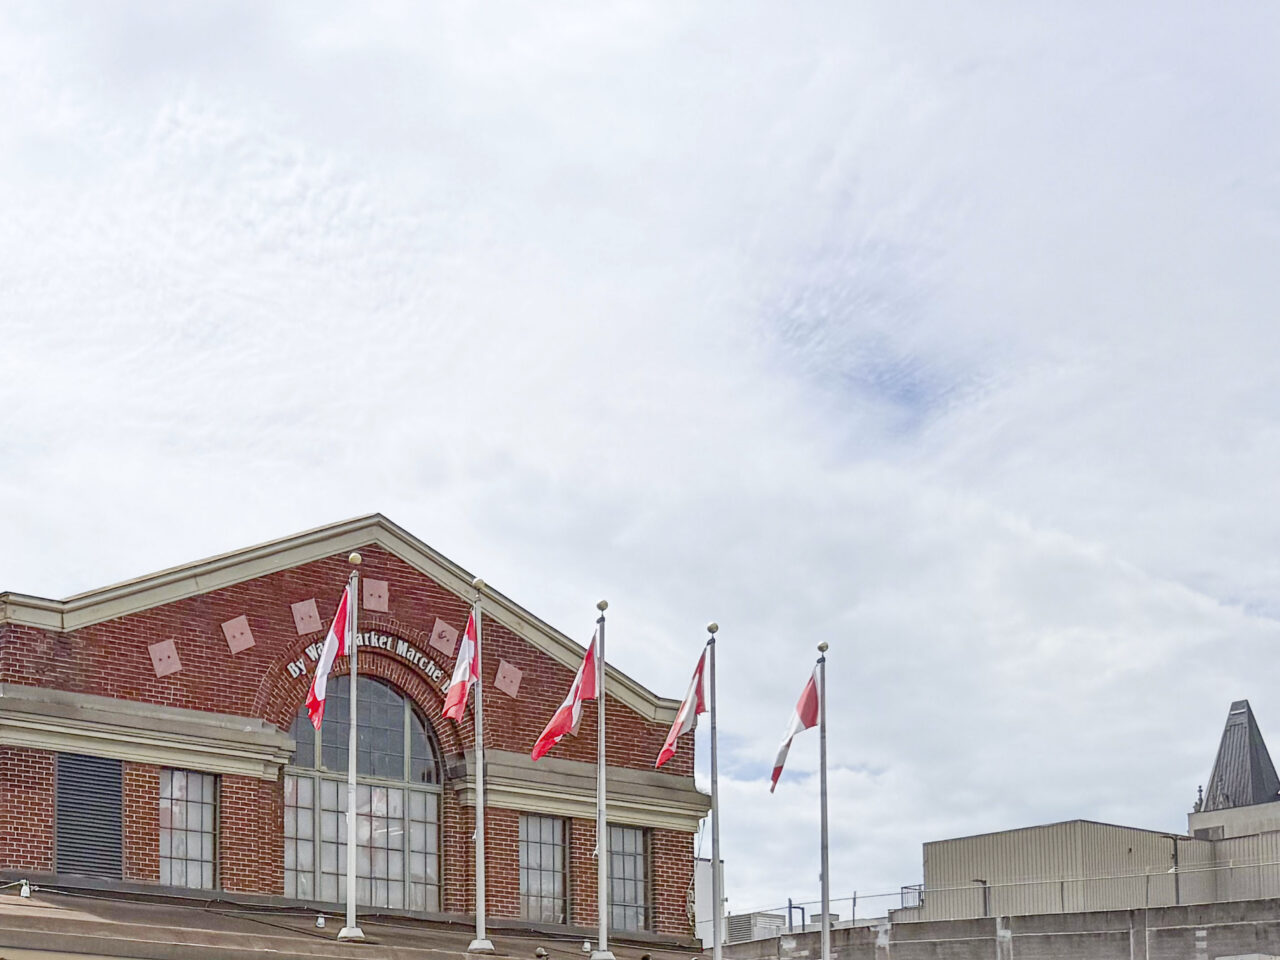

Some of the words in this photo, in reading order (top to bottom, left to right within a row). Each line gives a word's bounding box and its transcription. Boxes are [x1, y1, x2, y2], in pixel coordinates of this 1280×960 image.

[286, 658, 307, 679] By
[305, 641, 325, 662] Wa
[356, 631, 393, 651] arket
[395, 640, 443, 682] Marché
